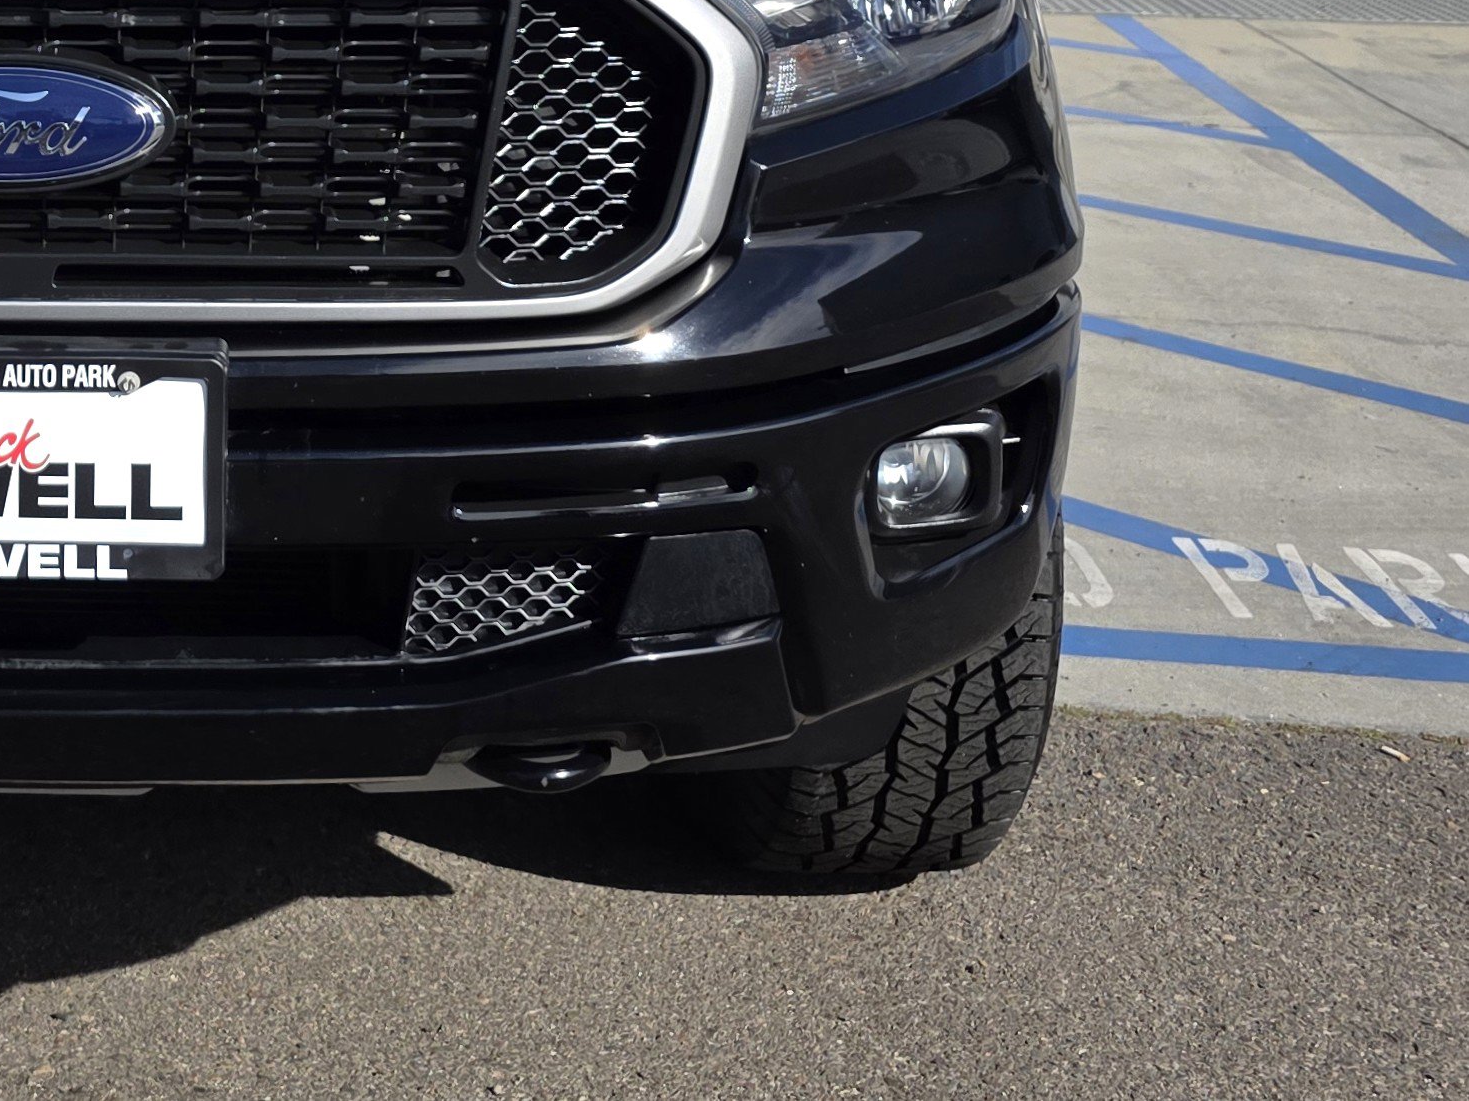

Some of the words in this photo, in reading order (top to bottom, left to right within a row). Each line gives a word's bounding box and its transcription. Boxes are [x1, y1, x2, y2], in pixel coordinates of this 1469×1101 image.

[2, 363, 57, 389] AUTO
[62, 364, 117, 389] PARK
[1172, 537, 1469, 630] PAR
